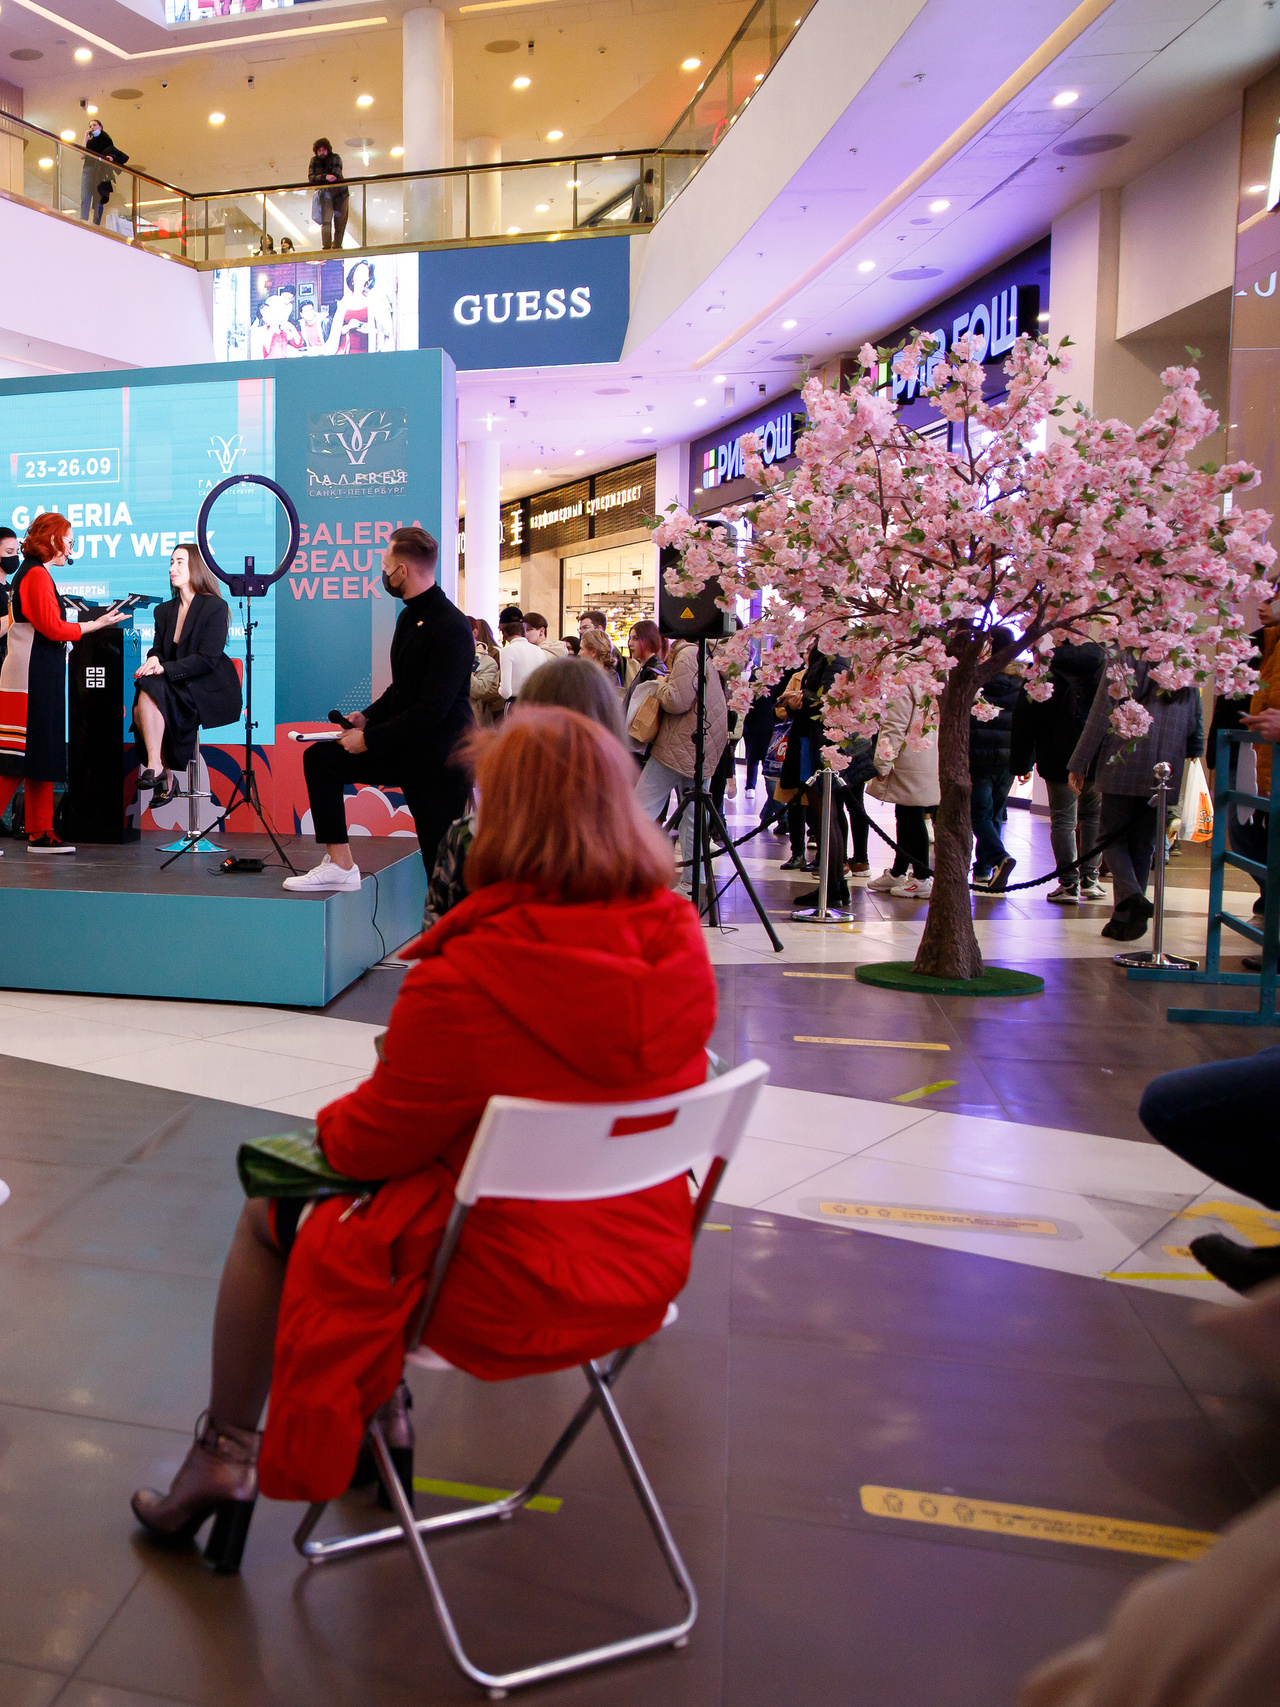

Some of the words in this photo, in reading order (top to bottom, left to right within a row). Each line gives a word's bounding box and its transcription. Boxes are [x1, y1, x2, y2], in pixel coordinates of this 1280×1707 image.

[453, 286, 592, 325] GUESS
[25, 456, 112, 479] 23-26.09
[717, 437, 746, 484] РИ
[308, 471, 408, 487] ГАЛЕРЕЯ
[308, 486, 406, 498] САНКТ-ПЕТЕРБУРГ
[586, 485, 642, 516] супермаркет
[289, 548, 388, 574] BEAUT
[57, 585, 106, 596] КСПЕРТЫ
[288, 576, 383, 600] WEEK
